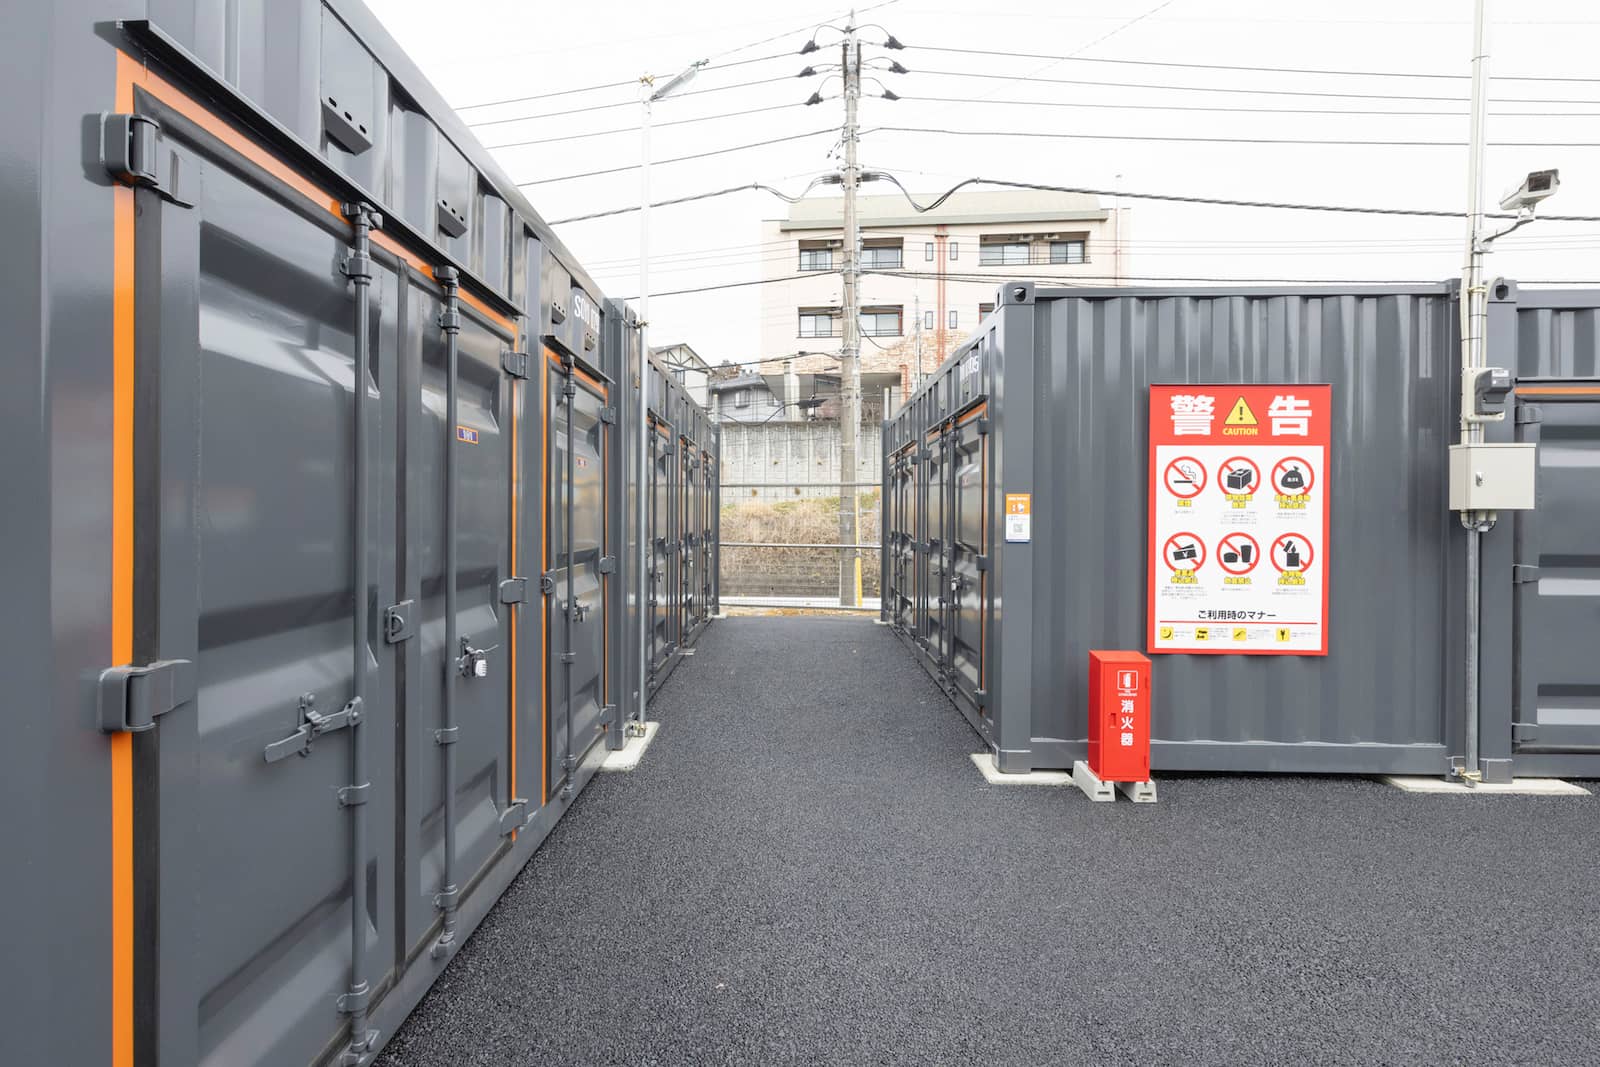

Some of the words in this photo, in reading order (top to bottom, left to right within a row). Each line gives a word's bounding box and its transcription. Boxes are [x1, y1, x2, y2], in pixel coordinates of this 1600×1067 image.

[1170, 394, 1215, 435] 警
[1268, 395, 1312, 436] 告
[1222, 427, 1258, 436] CAUTION
[1198, 610, 1277, 620] ご利用時のマナー
[1121, 699, 1134, 746] 消火器
